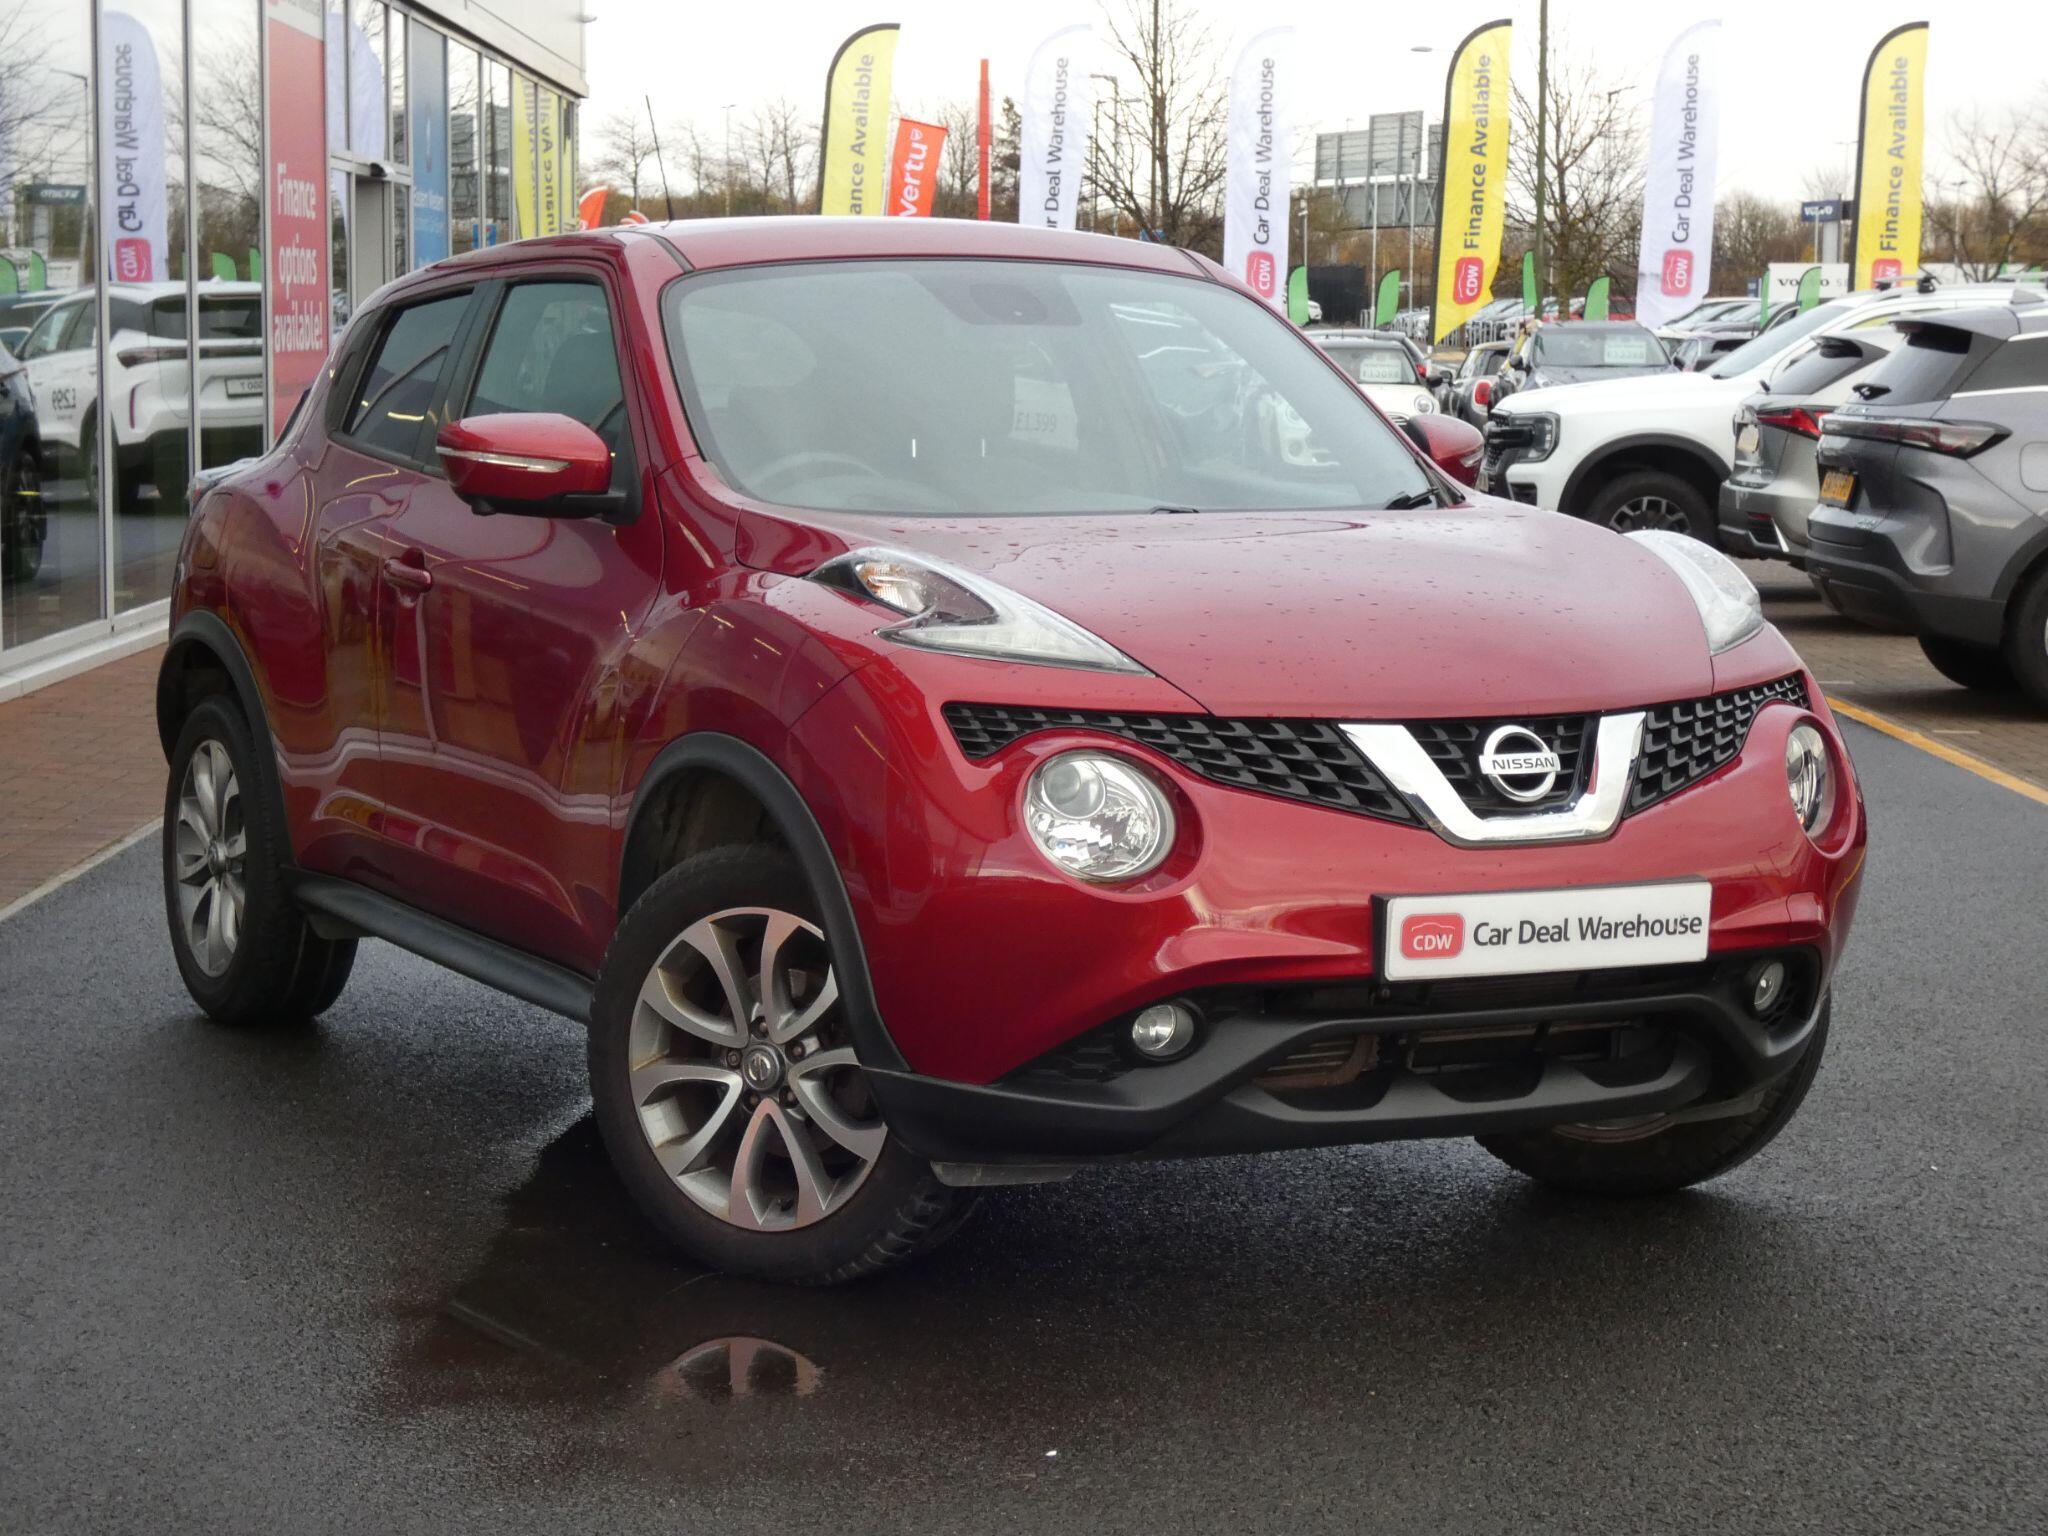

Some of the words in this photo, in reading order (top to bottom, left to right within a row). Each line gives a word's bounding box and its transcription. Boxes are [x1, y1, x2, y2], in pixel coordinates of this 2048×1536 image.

[850, 54, 874, 156] Available
[1046, 57, 1069, 164] Warehouse
[1254, 58, 1275, 162] Warehouse
[1471, 54, 1491, 157] Available
[1679, 54, 1700, 161] Warehouse
[1888, 56, 1909, 159] Available
[277, 163, 316, 220] Finance
[849, 163, 865, 214] ance
[899, 139, 928, 217] vertu
[1045, 169, 1061, 212] Deal
[1255, 169, 1271, 212] Deal
[1675, 168, 1694, 207] Deal
[1254, 215, 1270, 245] Car
[1464, 165, 1486, 249] Finance
[1672, 210, 1692, 243] Car
[1880, 166, 1902, 251] Finance
[279, 232, 317, 300] options
[1259, 264, 1270, 291] CDW
[1466, 264, 1478, 297] CDW
[1675, 257, 1687, 289] CDW
[1778, 278, 1830, 287] VOO
[273, 300, 323, 353] available!
[1491, 757, 1556, 770] NISSAN
[1412, 934, 1453, 950] CDW
[1473, 923, 1513, 946] Car
[1518, 922, 1569, 944] Deal
[1578, 914, 1703, 939] Warehouse
